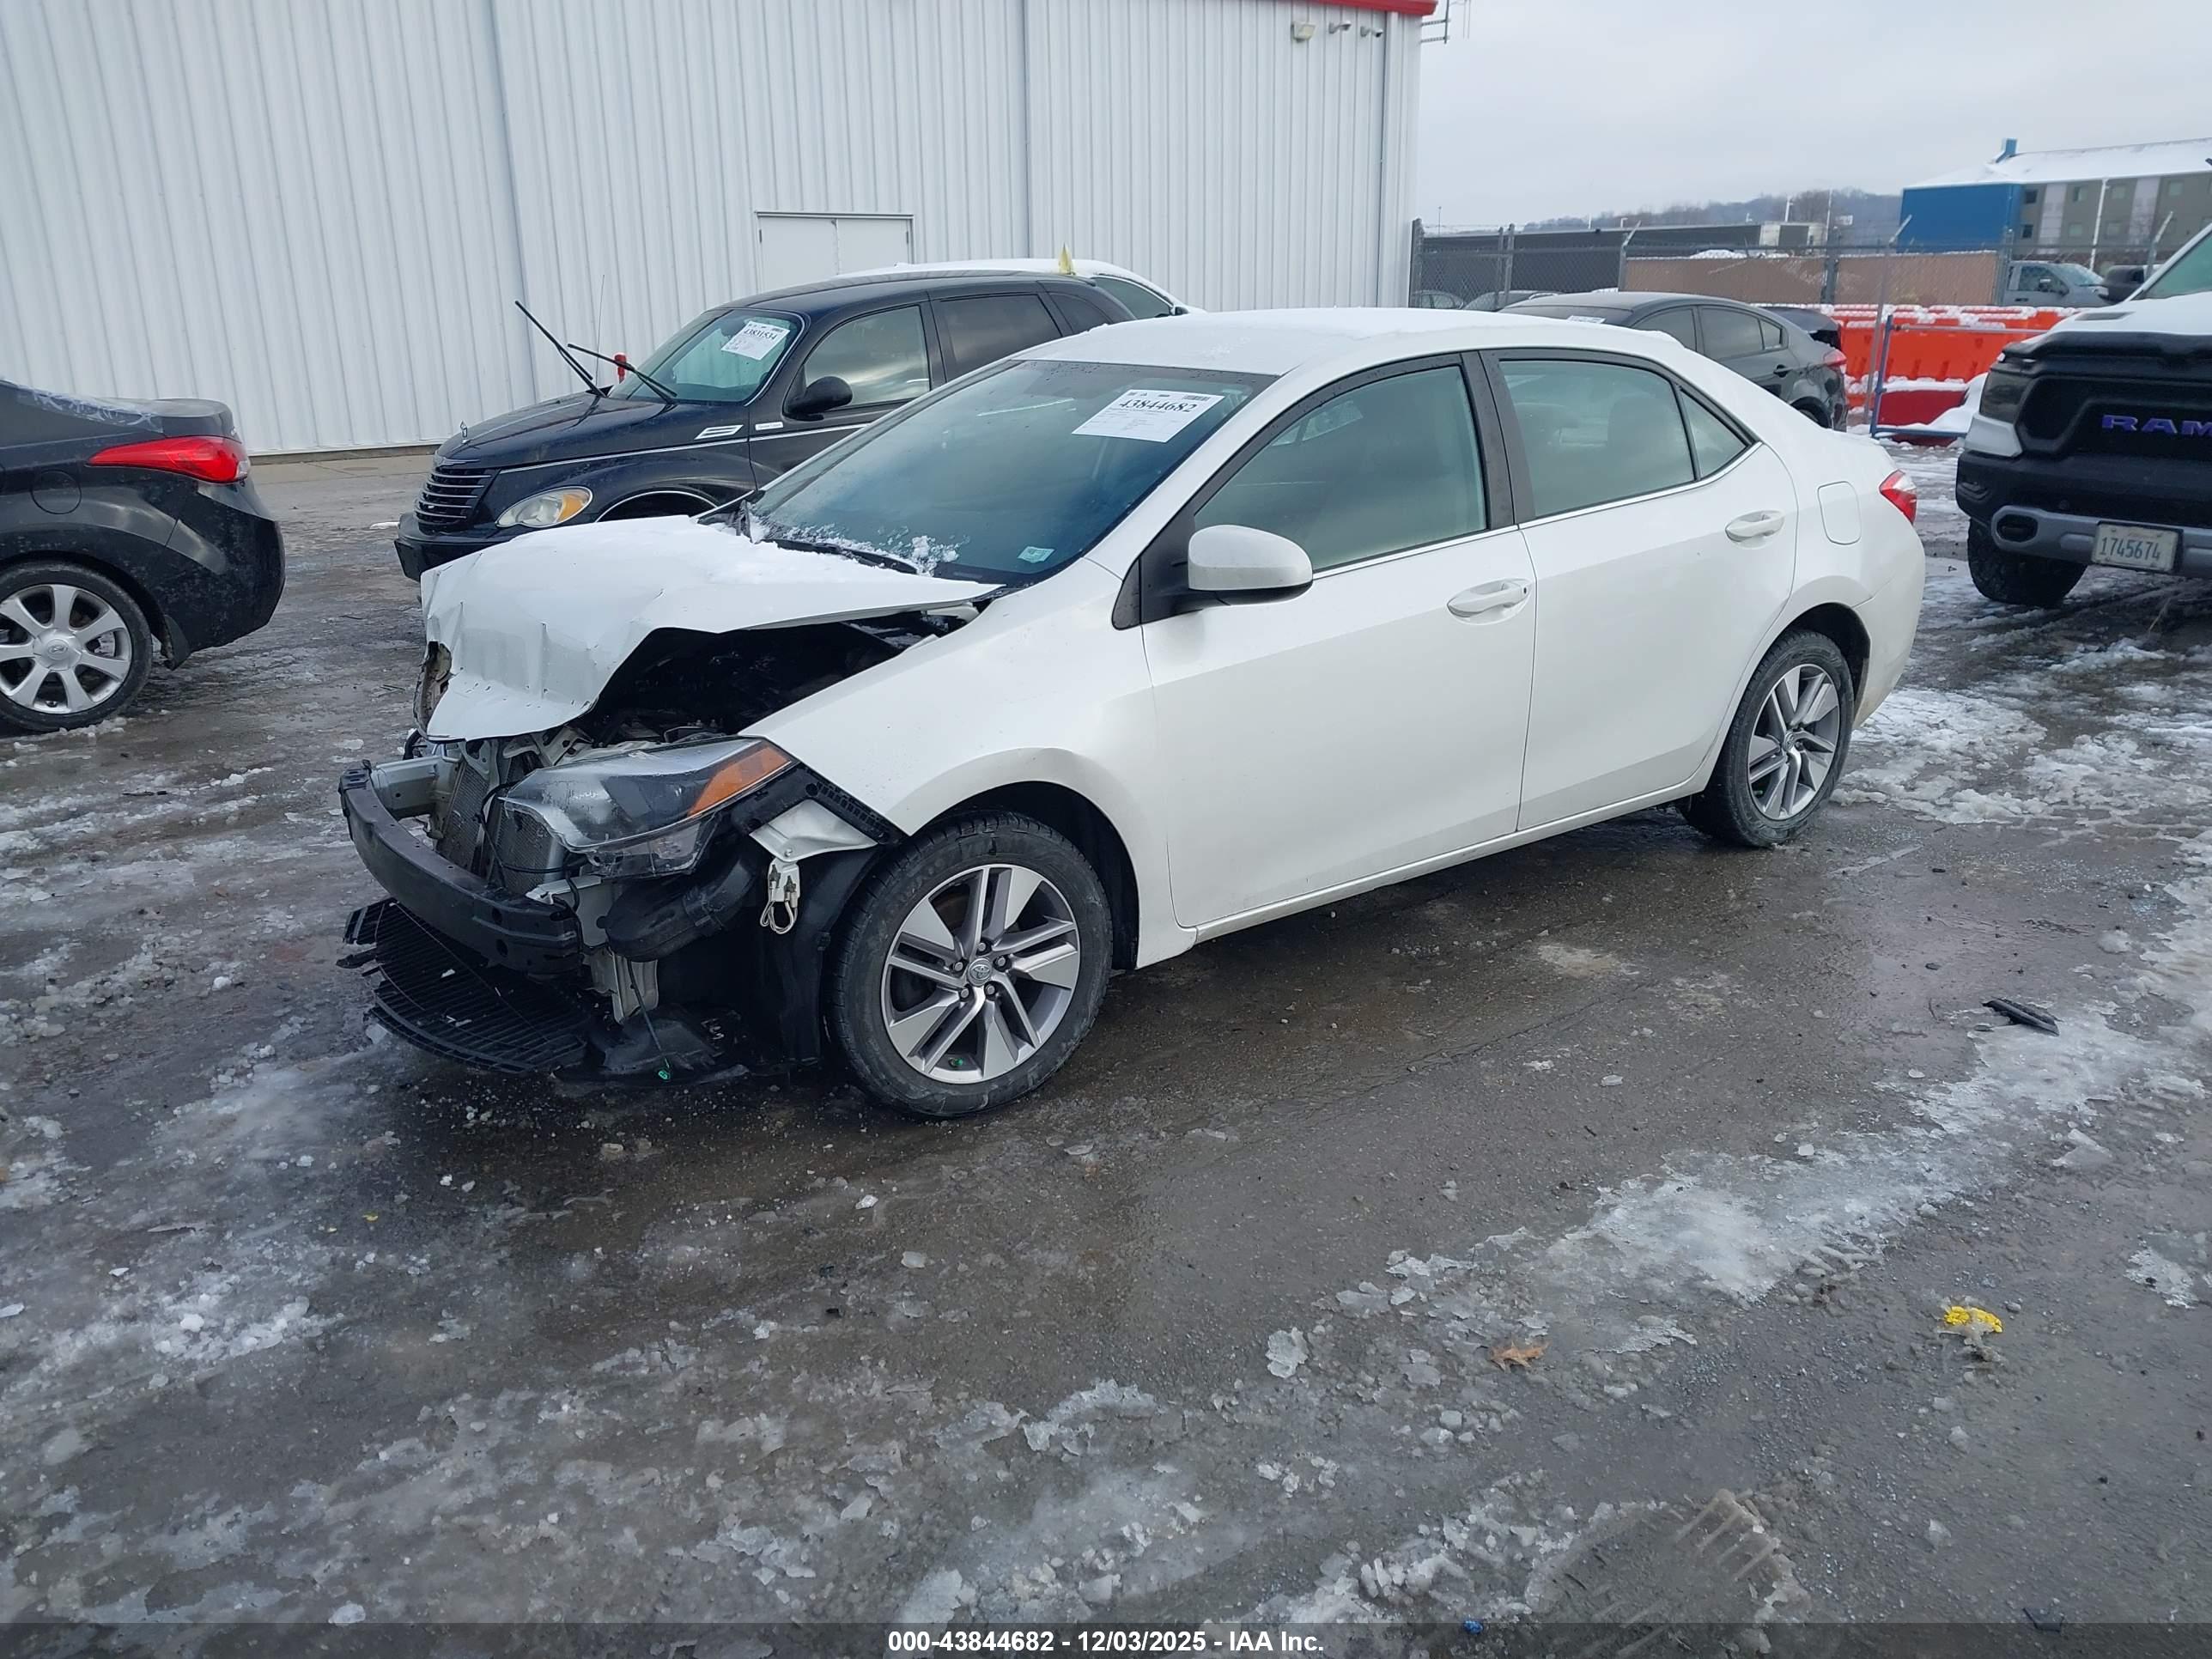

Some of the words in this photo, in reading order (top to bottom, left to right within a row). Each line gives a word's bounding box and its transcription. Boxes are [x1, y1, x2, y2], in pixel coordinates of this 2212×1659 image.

[1119, 398, 1198, 413] 43844682
[2101, 414, 2212, 436] RAM
[2099, 537, 2161, 562] 1745674
